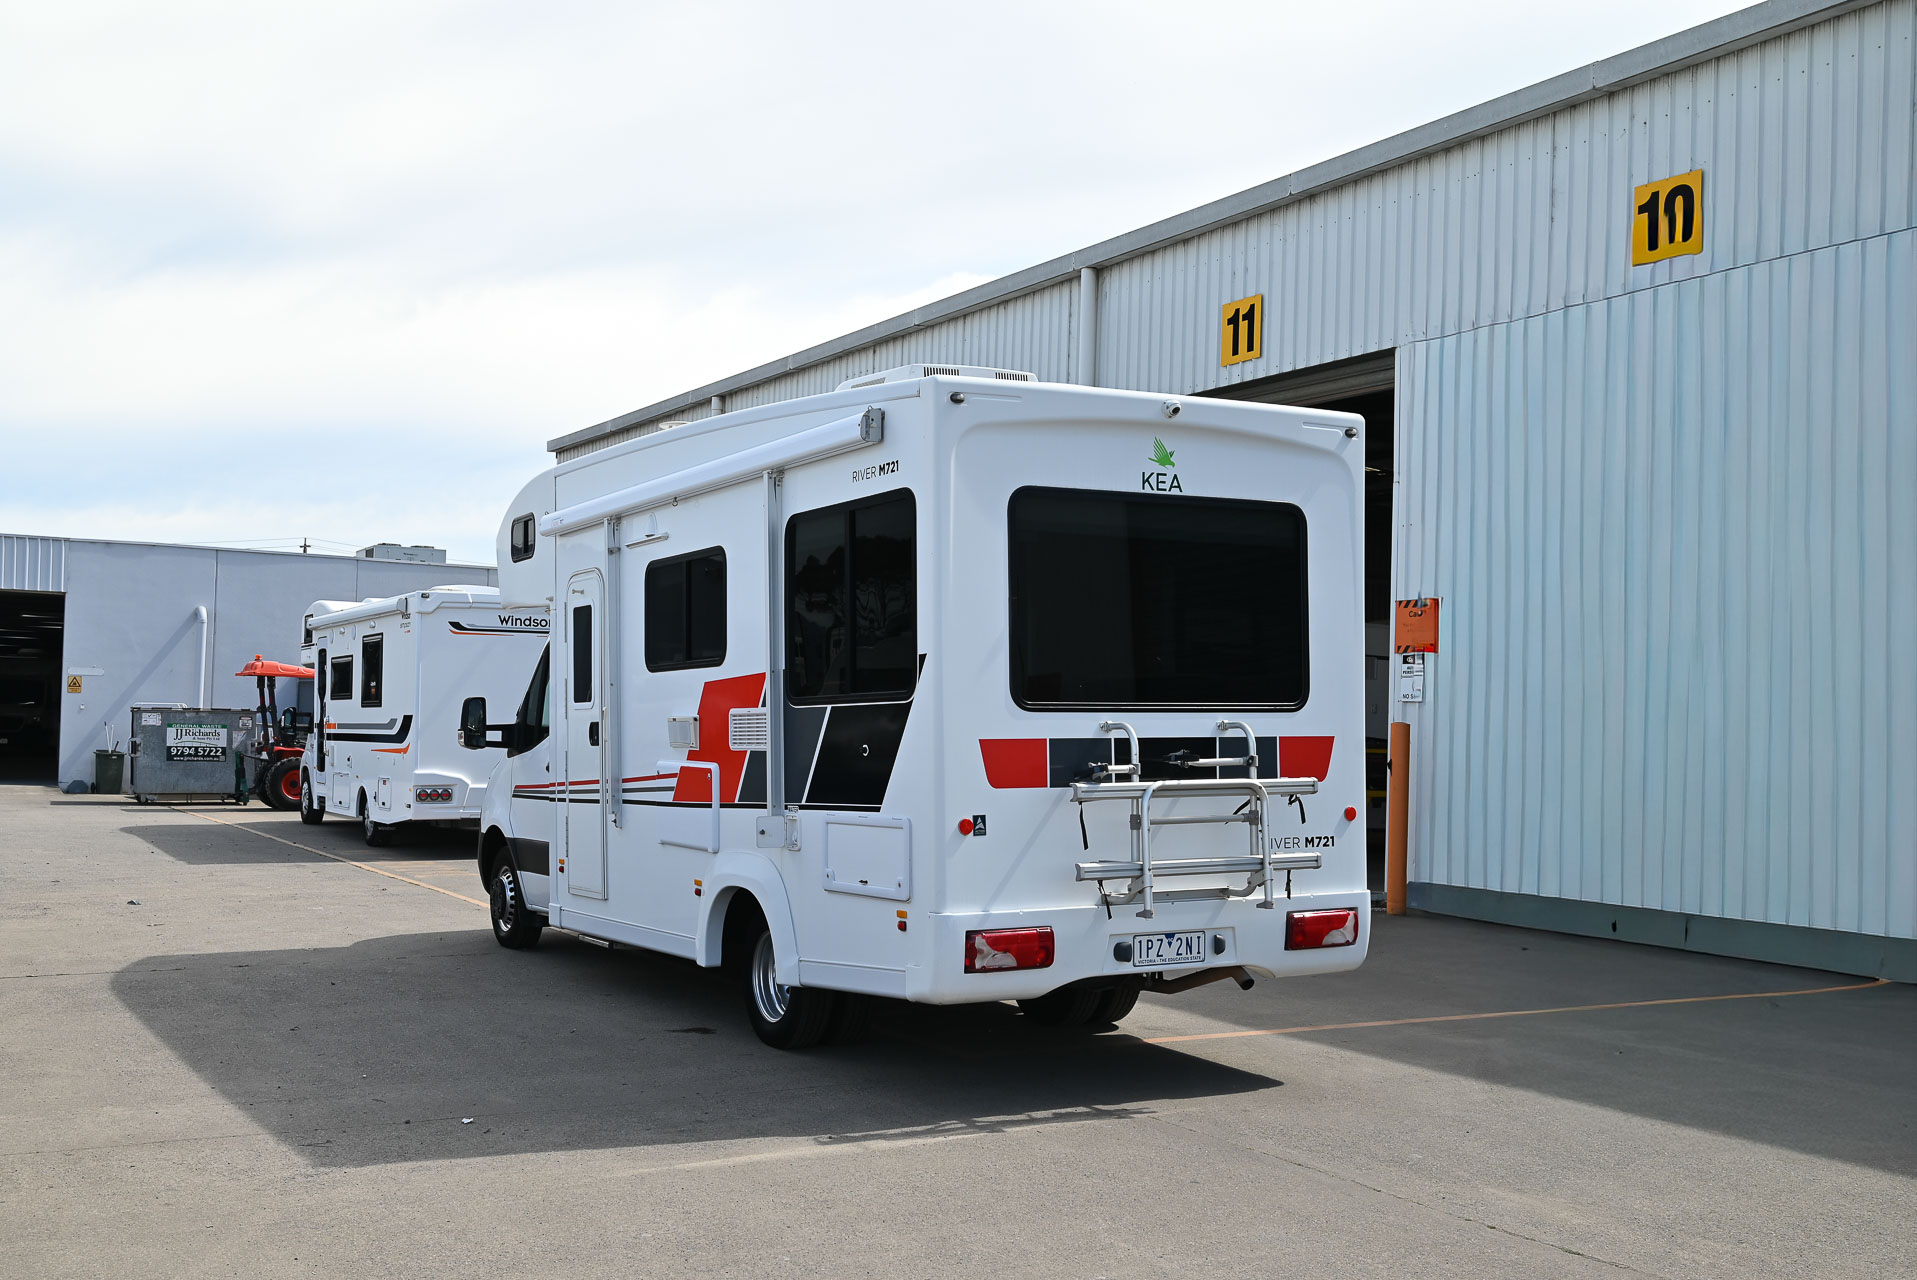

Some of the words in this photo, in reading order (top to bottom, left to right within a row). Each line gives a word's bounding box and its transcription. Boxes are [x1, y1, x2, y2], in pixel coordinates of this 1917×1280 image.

[1637, 183, 1695, 252] 10
[1226, 303, 1256, 357] 11
[852, 465, 877, 483] RIVER
[878, 459, 899, 477] M721
[1141, 471, 1183, 493] KEA
[498, 614, 551, 628] Windso
[184, 728, 221, 737] Richards
[171, 747, 195, 755] 9794
[197, 747, 222, 756] 5722
[1270, 836, 1301, 850] IVER
[1304, 835, 1335, 848] M721
[1138, 938, 1164, 959] 1PZ
